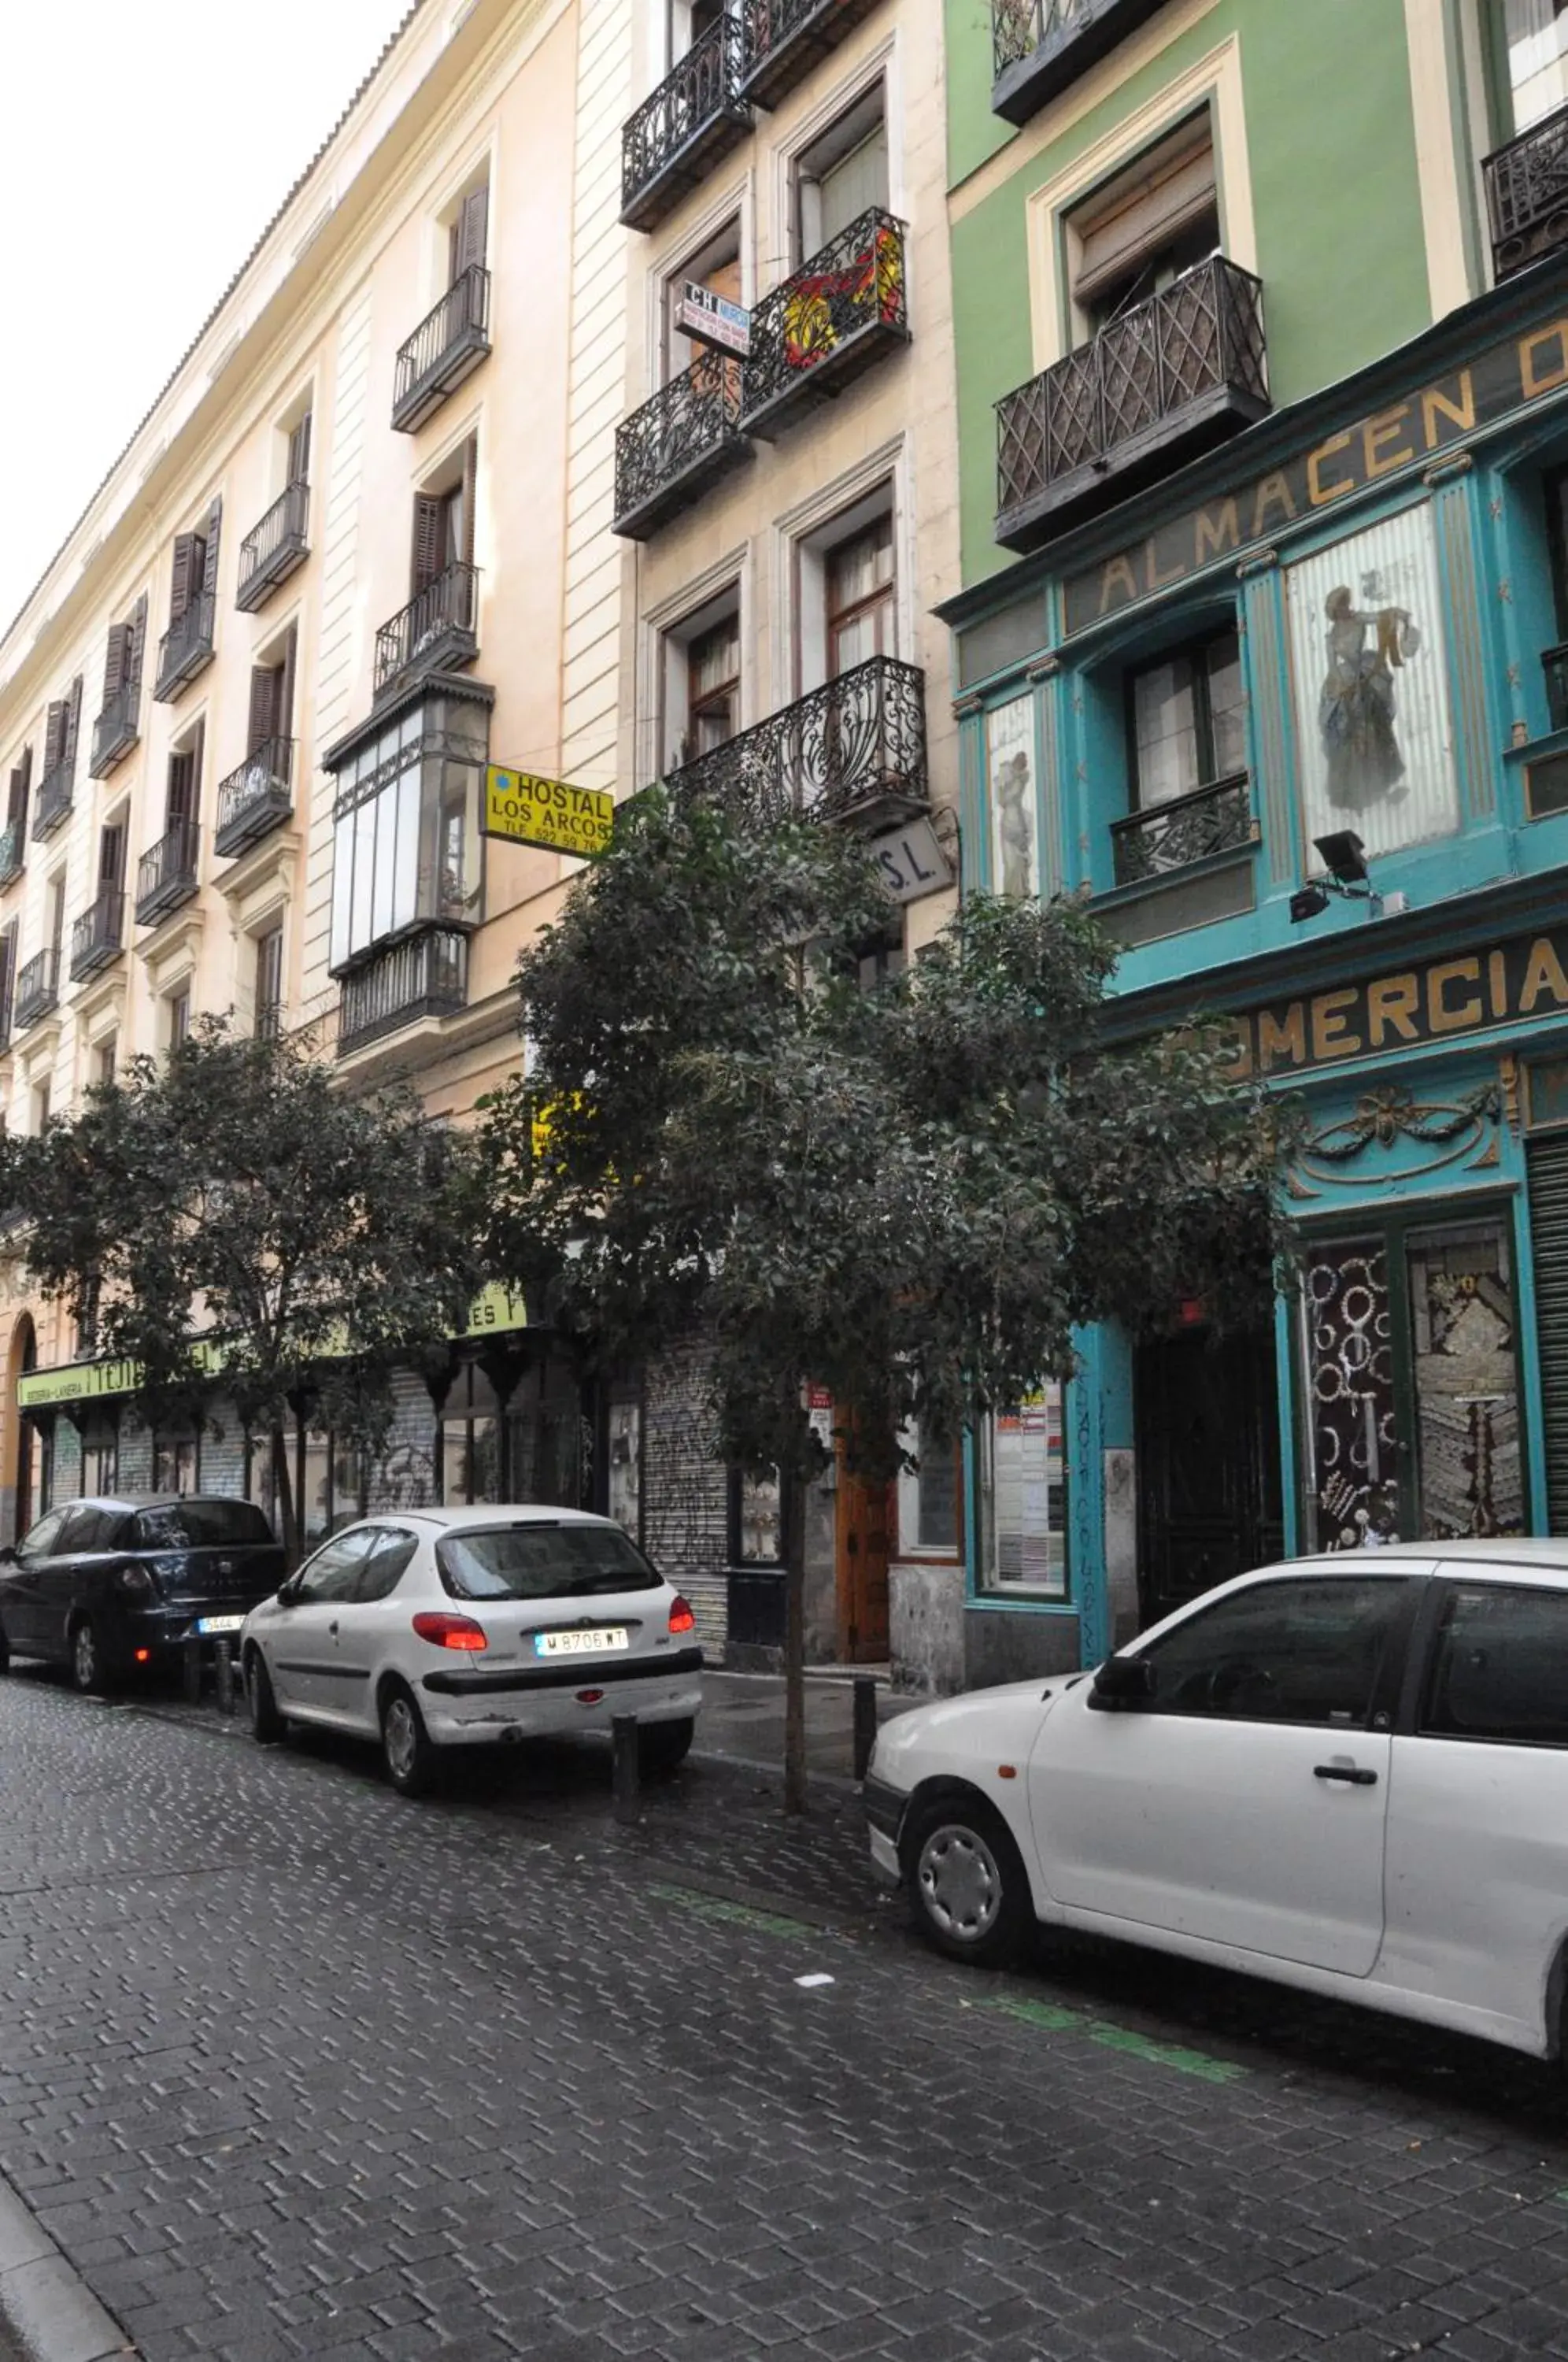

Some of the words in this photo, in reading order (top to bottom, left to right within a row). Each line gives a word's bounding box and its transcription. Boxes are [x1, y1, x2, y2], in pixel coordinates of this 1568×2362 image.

[691, 287, 712, 310] CH
[1099, 368, 1475, 616] ALMACEN
[492, 796, 531, 821] LOS
[542, 809, 609, 840] ARCOS
[518, 775, 608, 820] HOSTAL
